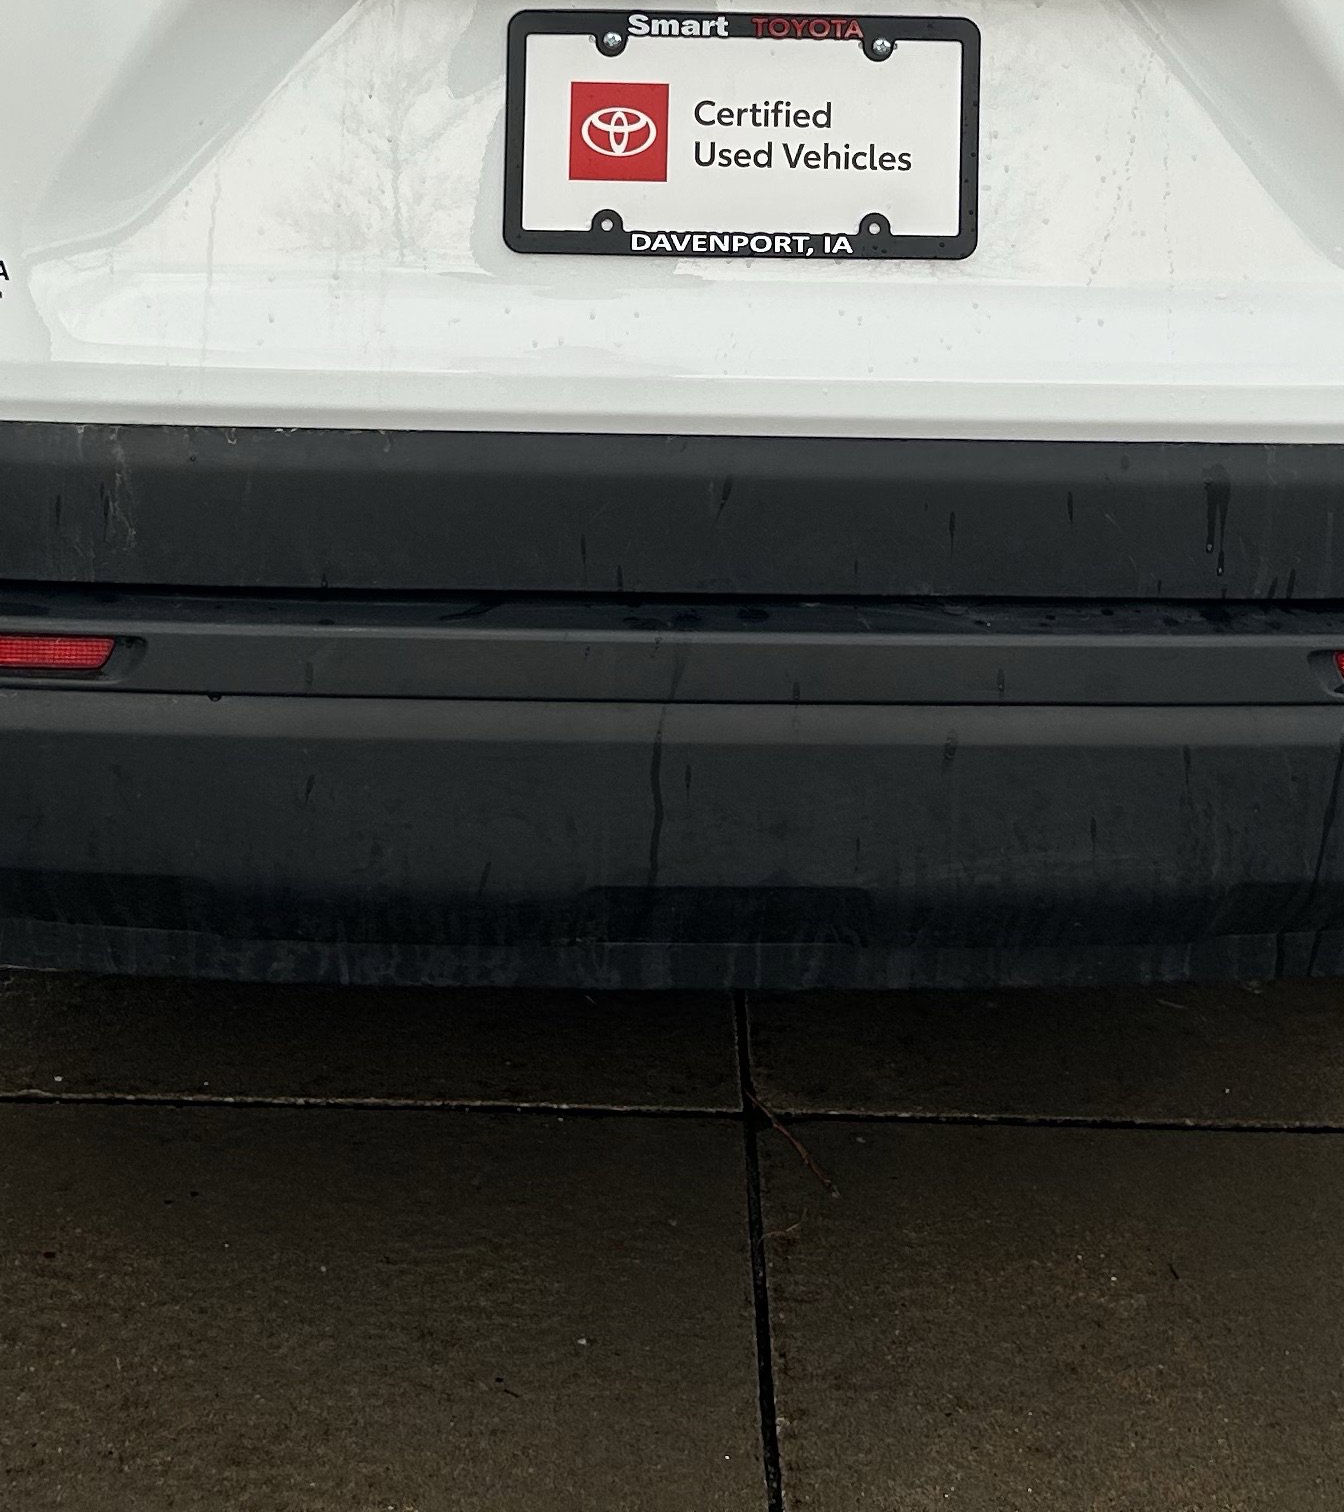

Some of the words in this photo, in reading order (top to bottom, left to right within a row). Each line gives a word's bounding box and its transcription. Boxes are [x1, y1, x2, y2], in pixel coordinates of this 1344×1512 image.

[627, 14, 729, 39] Smart
[751, 17, 864, 40] TOYOTA
[693, 101, 833, 129] Certified
[693, 141, 773, 170] Used
[782, 143, 912, 171] Vehicles
[631, 232, 814, 257] DAVENPORT,
[823, 235, 854, 255] IA
